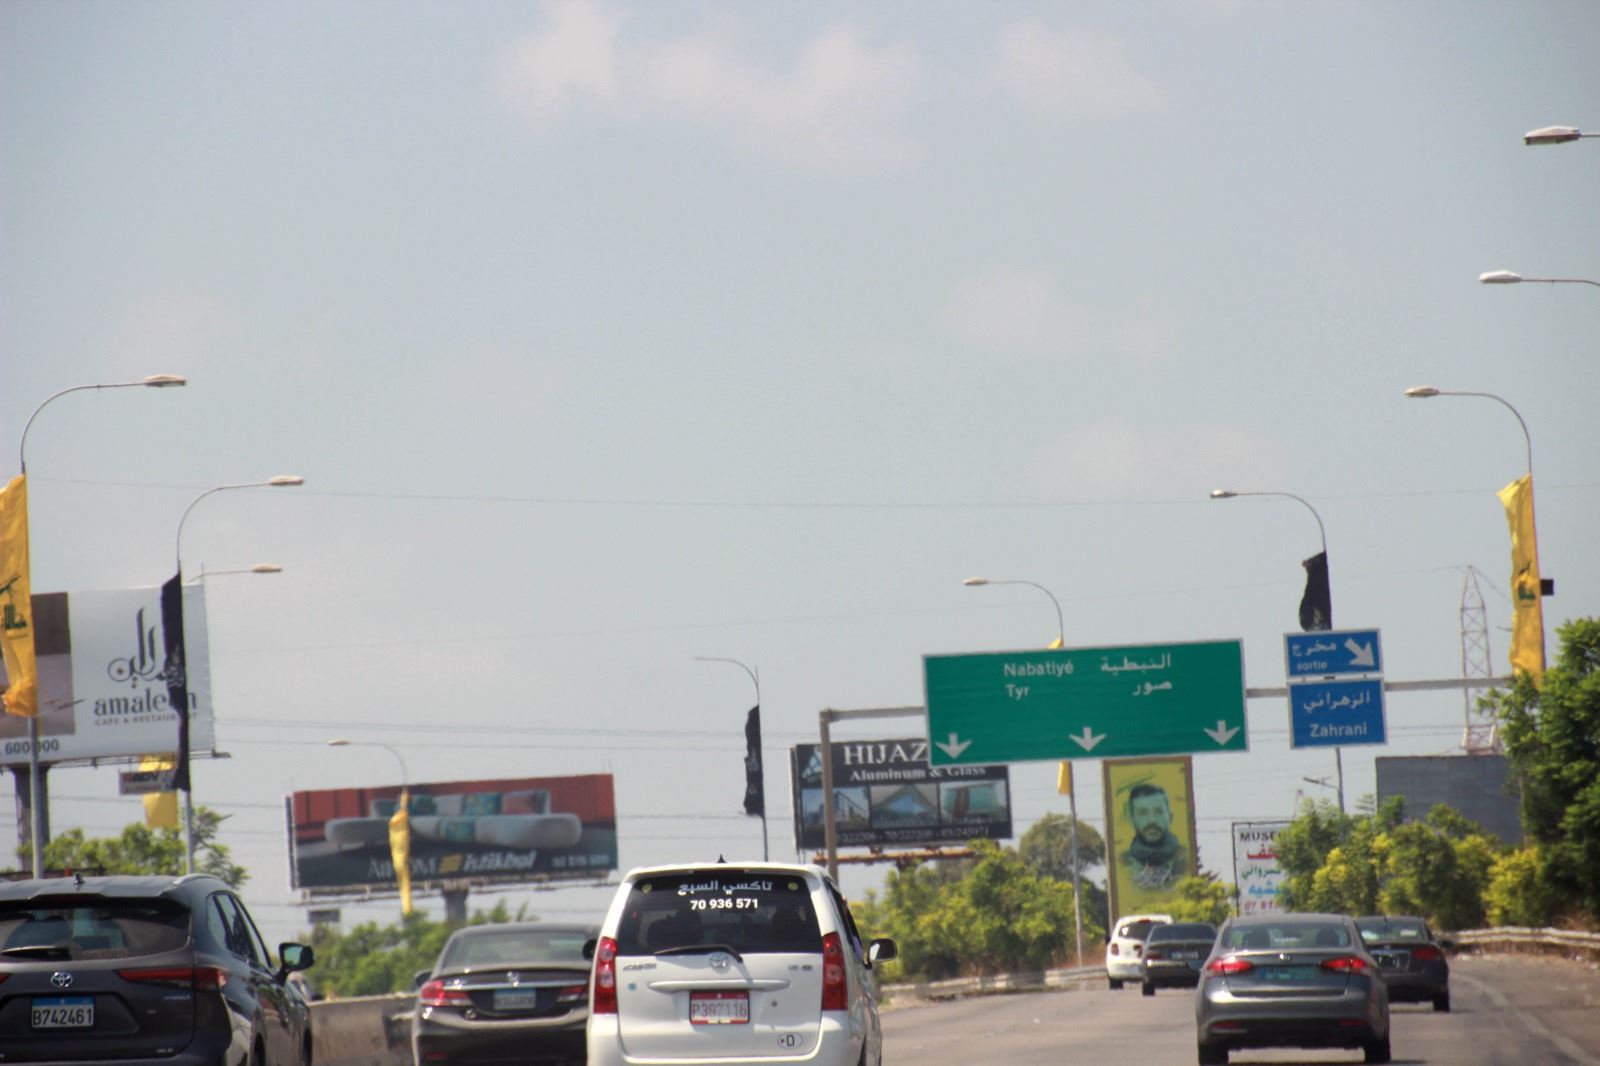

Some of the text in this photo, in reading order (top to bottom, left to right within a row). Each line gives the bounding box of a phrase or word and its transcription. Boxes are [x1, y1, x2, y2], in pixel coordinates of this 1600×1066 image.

[1292, 639, 1337, 657] مخرج
[1003, 660, 1074, 677] Nabatiyé
[1100, 652, 1171, 676] النبطية
[1005, 684, 1030, 700] Tyr
[1132, 679, 1173, 697] صور
[93, 686, 198, 717] amalen
[1303, 690, 1370, 714] الزهراني
[1310, 721, 1368, 738] Zahrani
[843, 743, 929, 765] HIJAZ
[849, 768, 926, 783] Aluminum
[677, 879, 774, 896] تاكسي السبع
[690, 898, 759, 910] 70 936 571
[32, 1008, 92, 1026] B742461
[786, 1034, 795, 1047] D
